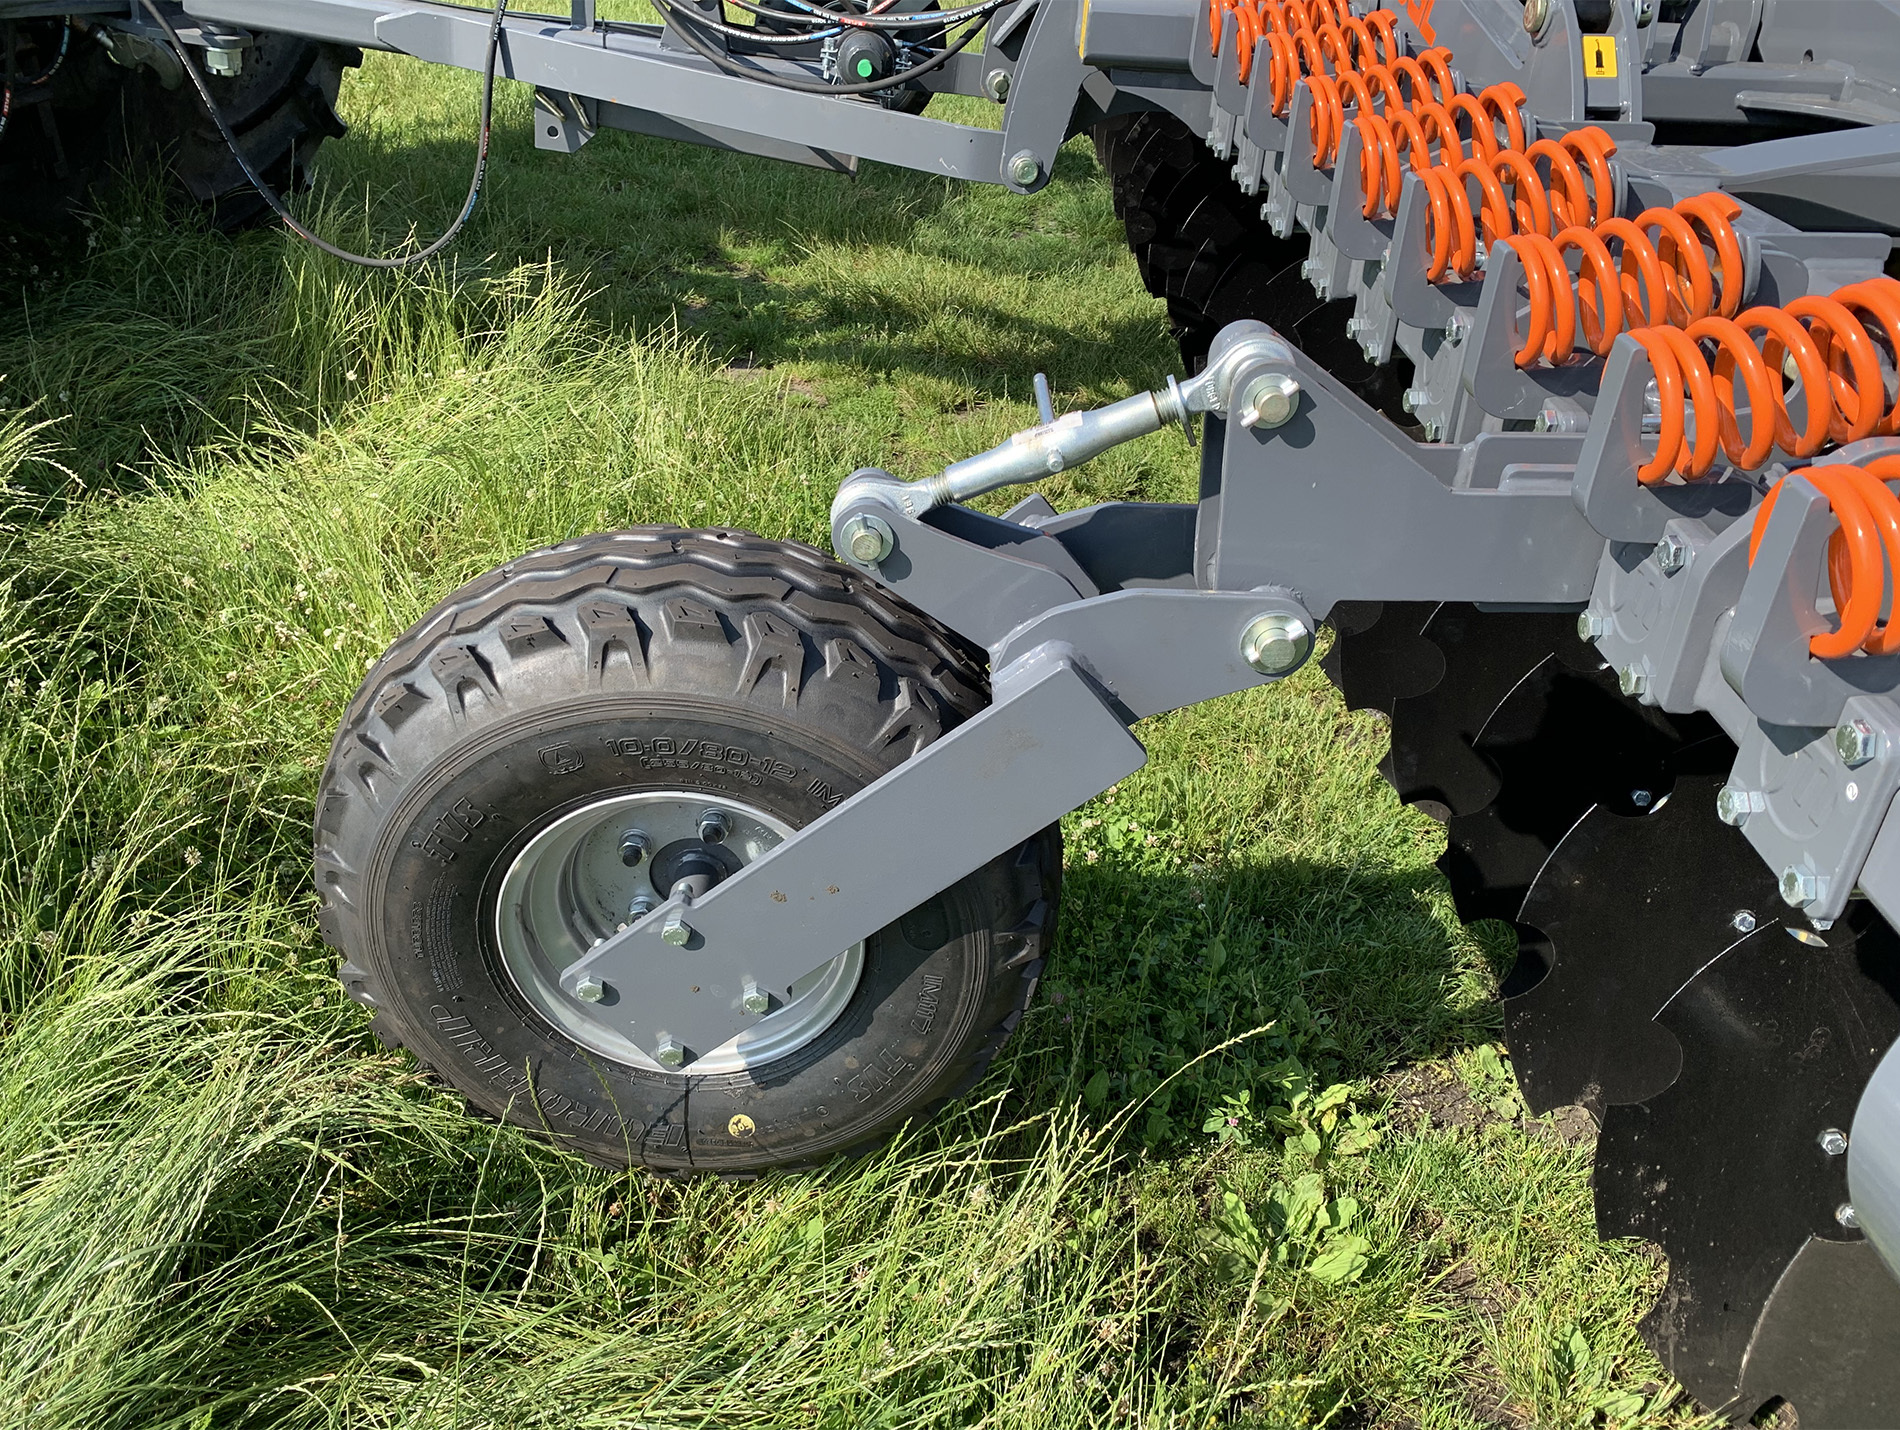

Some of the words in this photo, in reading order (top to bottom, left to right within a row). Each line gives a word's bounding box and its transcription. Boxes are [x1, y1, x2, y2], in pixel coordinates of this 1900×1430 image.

[422, 796, 488, 865] TVS
[910, 973, 945, 1036] IM117
[846, 1047, 909, 1104] TVS
